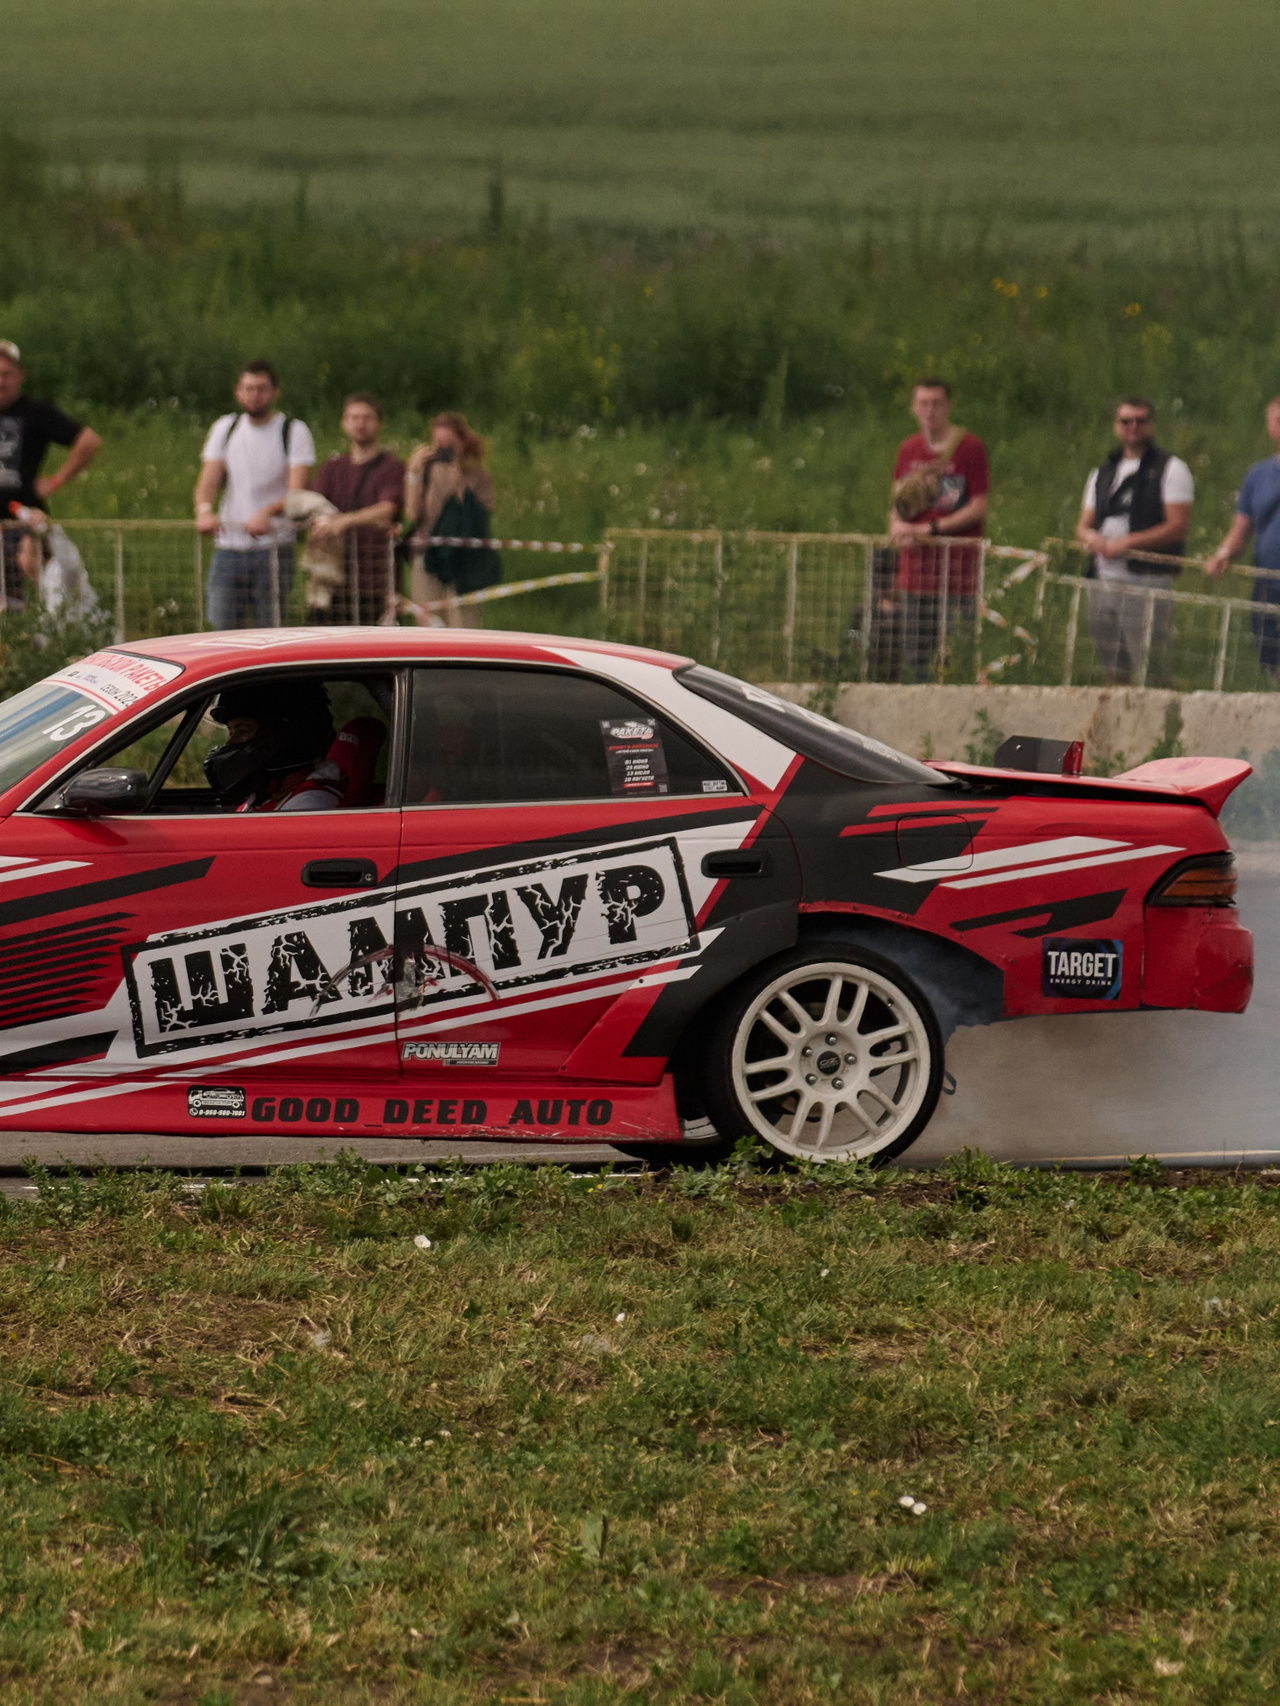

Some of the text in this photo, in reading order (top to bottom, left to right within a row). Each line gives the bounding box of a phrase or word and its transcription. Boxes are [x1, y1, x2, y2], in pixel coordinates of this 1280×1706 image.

[42, 704, 106, 741] 13
[149, 864, 666, 1034] ШАМПУР
[1047, 950, 1118, 978] TARGET
[1050, 977, 1082, 985] ENERGY
[402, 1043, 499, 1059] PONULYAM
[251, 1097, 613, 1126] GOOD DEED AUTO
